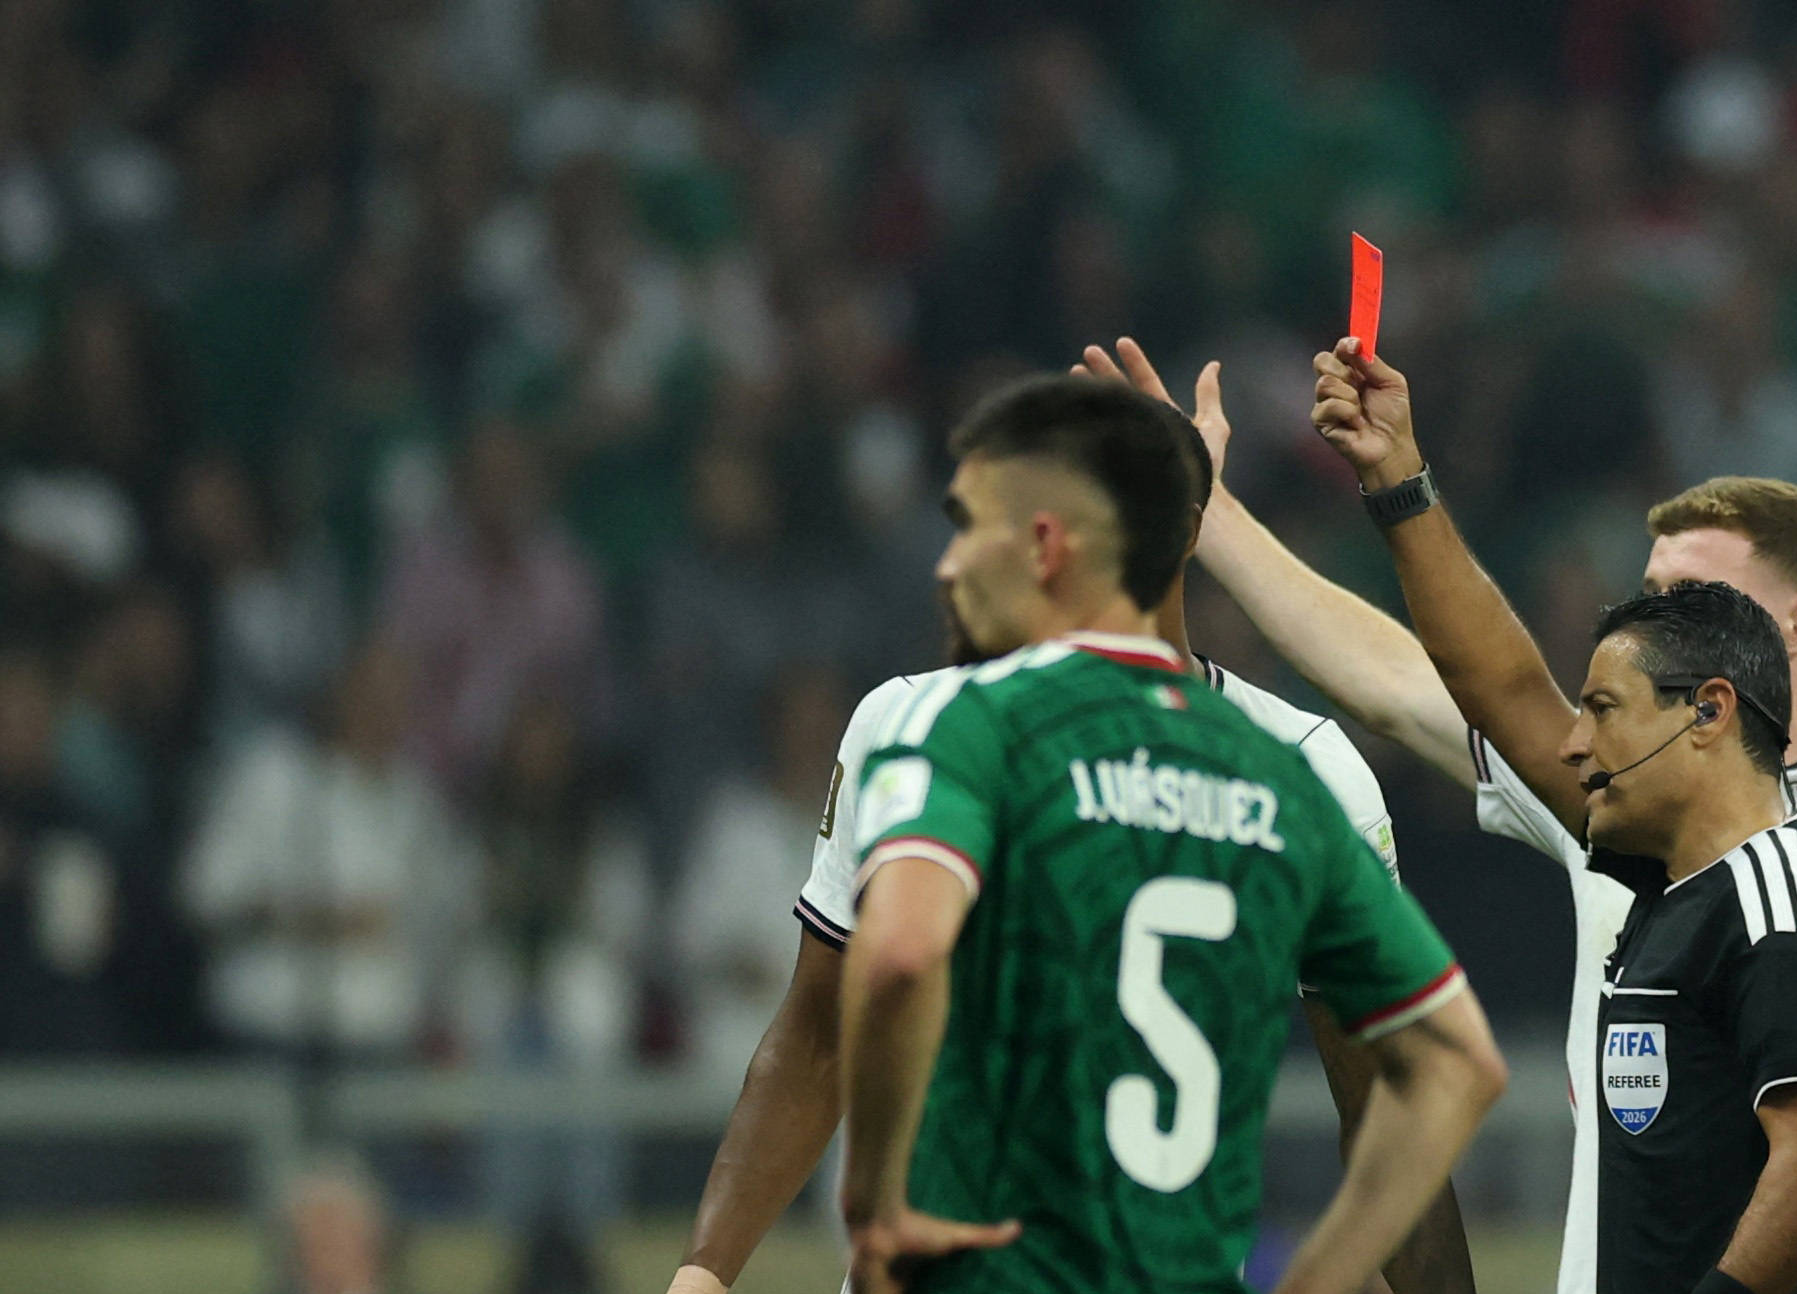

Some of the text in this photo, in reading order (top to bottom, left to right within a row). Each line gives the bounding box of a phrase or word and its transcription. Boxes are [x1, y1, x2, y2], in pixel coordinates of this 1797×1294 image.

[1106, 876, 1237, 1193] 5
[1608, 1031, 1659, 1057] FIFA
[1608, 1075, 1662, 1089] REFEREE
[1621, 1111, 1647, 1124] 2026
